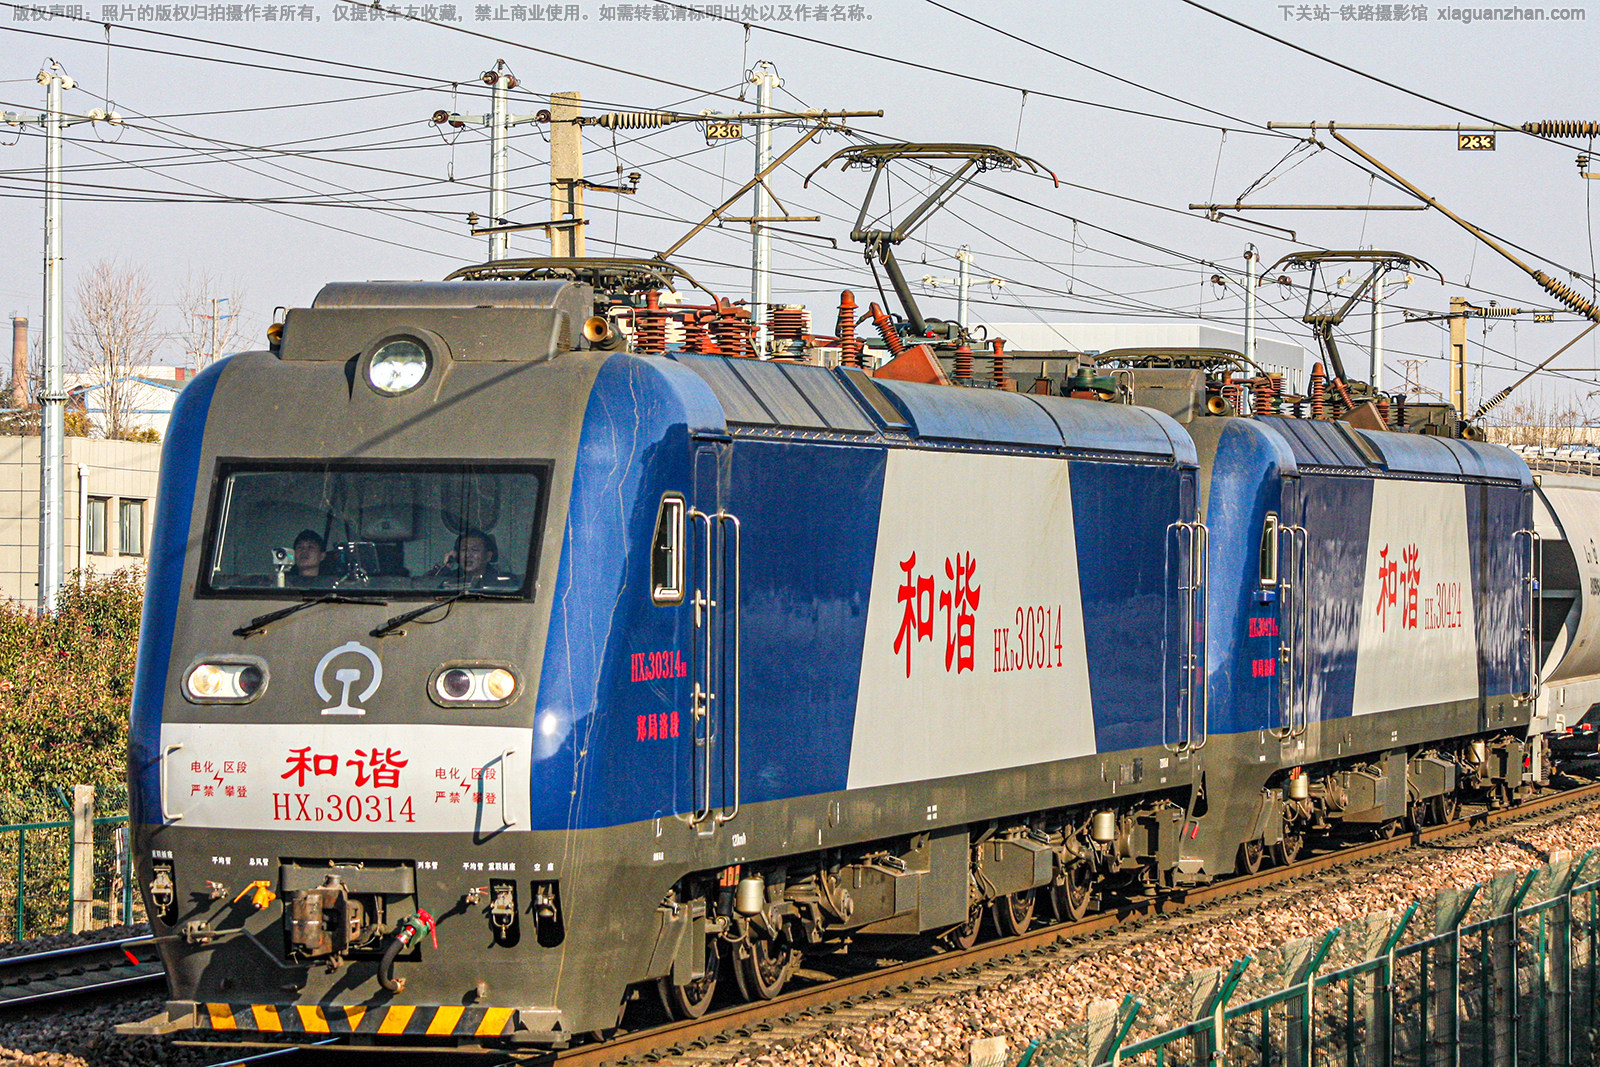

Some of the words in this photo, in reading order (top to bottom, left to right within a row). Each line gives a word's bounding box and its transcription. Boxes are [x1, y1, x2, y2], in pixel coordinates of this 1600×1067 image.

[708, 125, 740, 138] 236
[1461, 136, 1493, 149] 233
[1376, 543, 1421, 633] 和谐
[894, 551, 981, 678] 和谐
[994, 605, 1063, 672] HXD30314
[280, 746, 409, 788] 和谐
[272, 793, 416, 823] HXD30314
